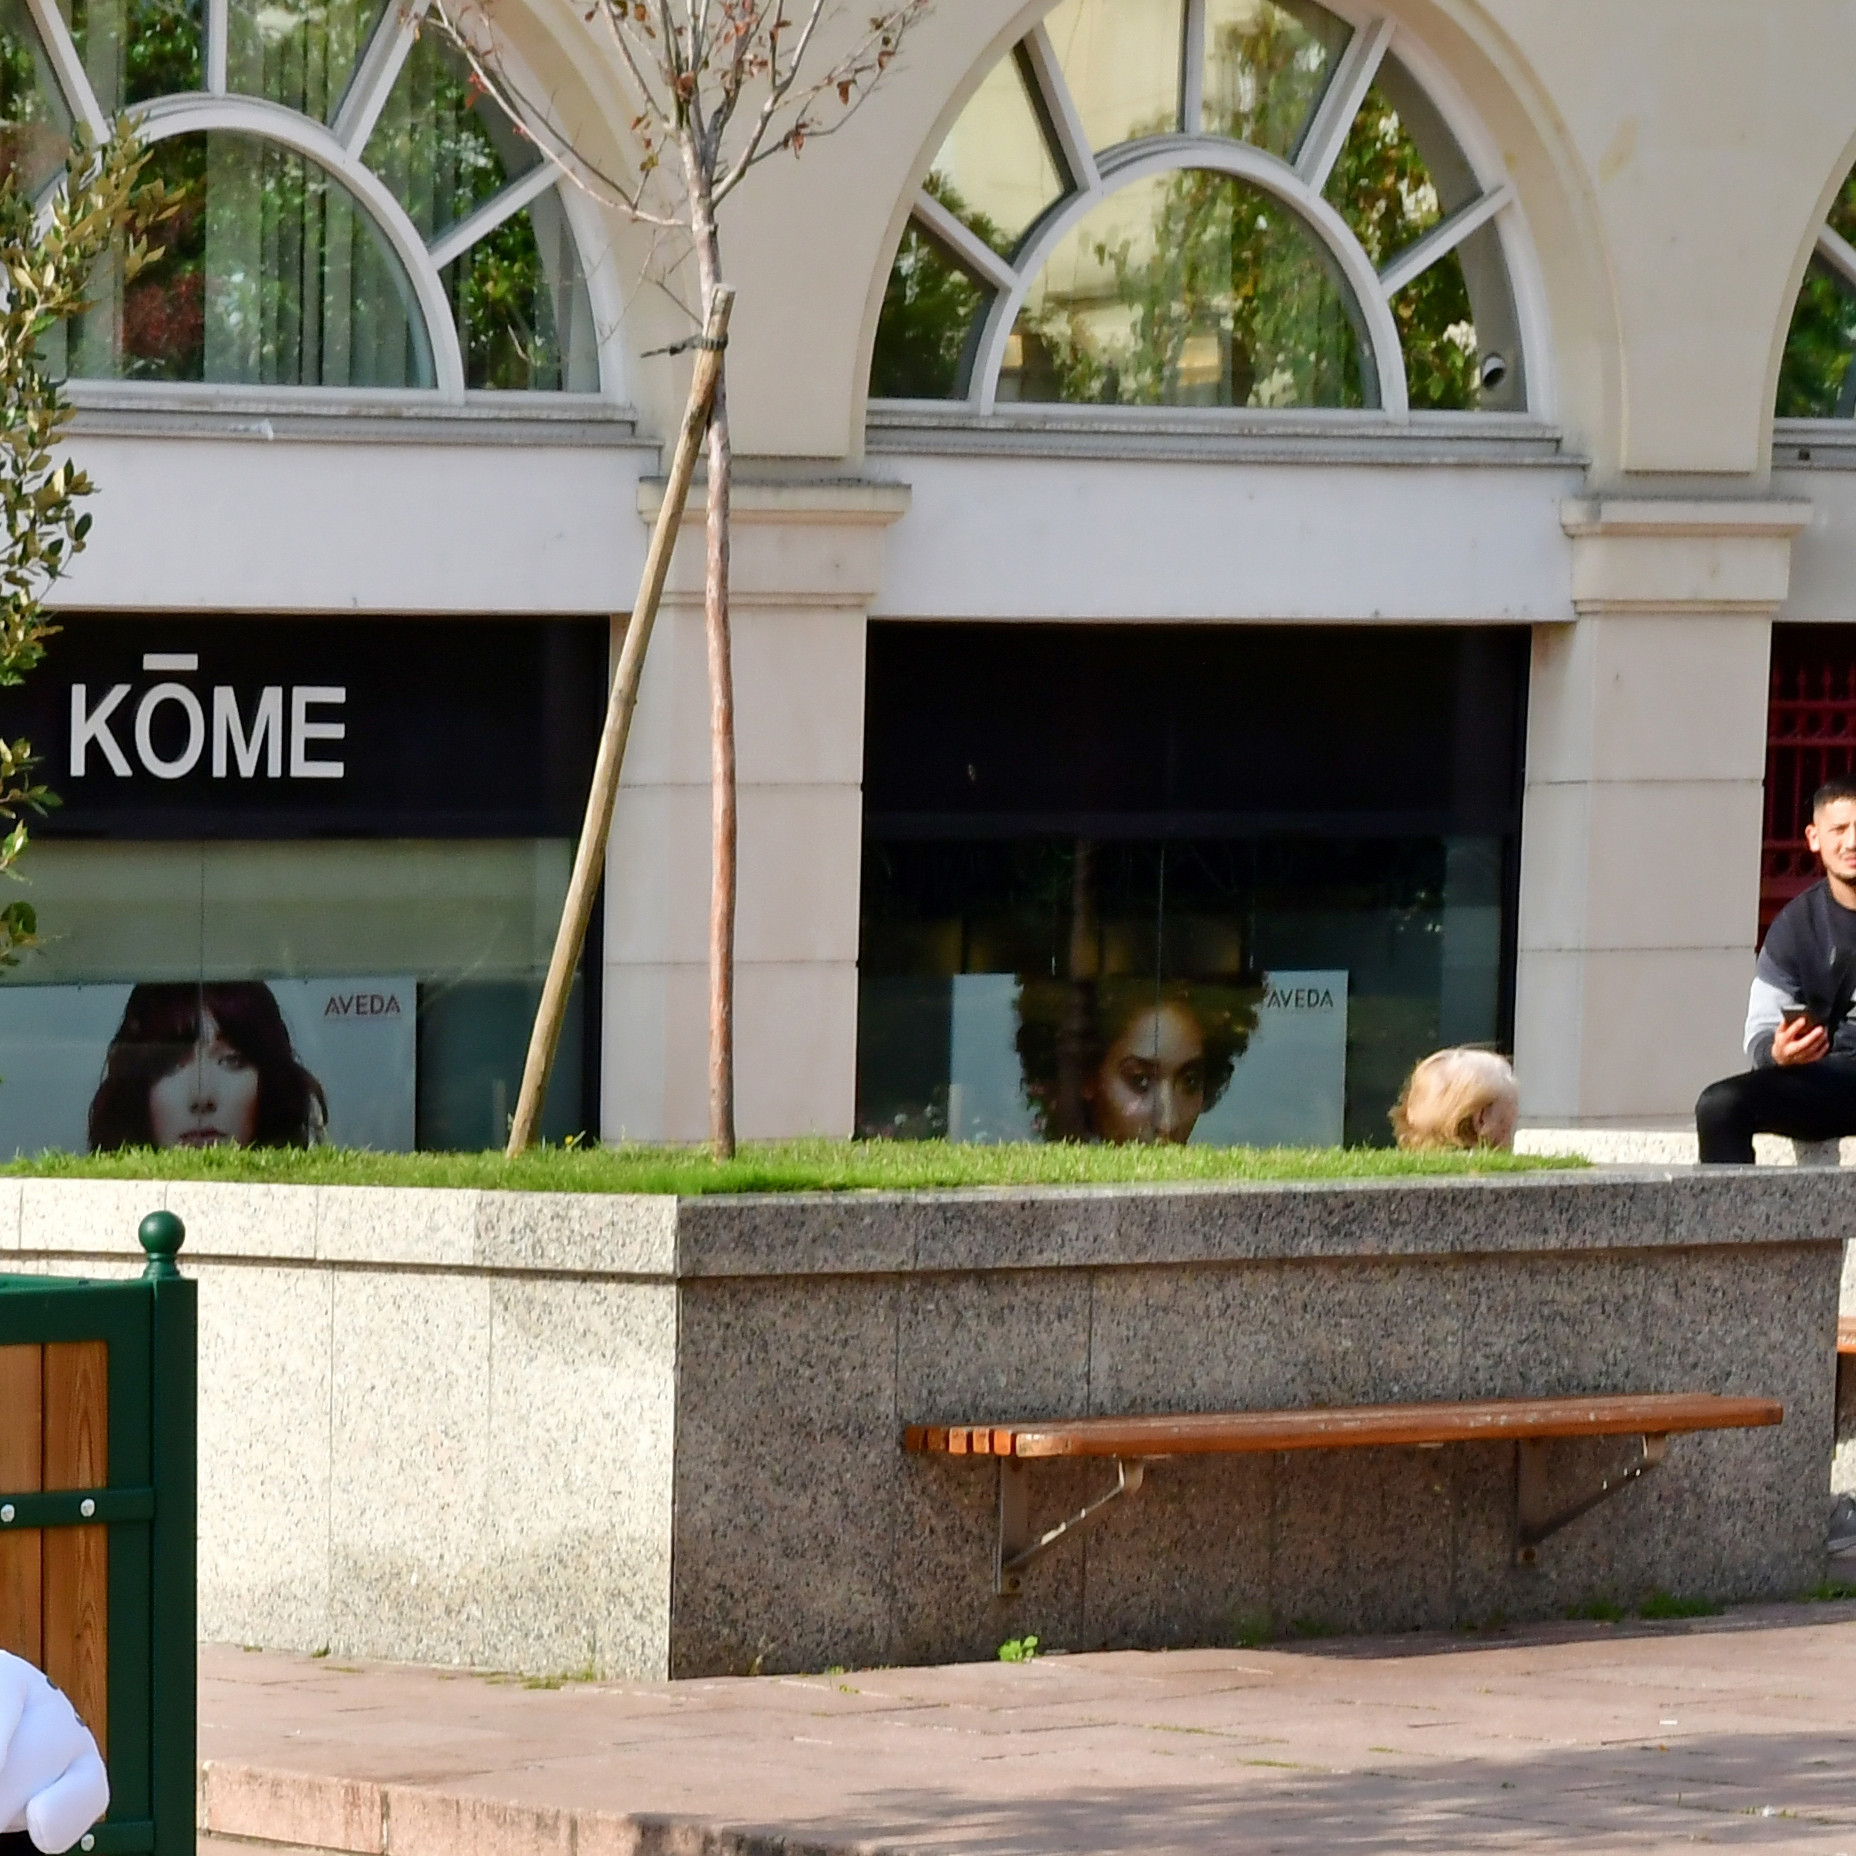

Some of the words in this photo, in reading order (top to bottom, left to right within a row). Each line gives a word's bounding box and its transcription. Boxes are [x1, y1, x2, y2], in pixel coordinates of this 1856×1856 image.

[69, 652, 347, 780] KŌME
[323, 993, 401, 1016] AVEDA
[1266, 987, 1335, 1009] AVEDA
